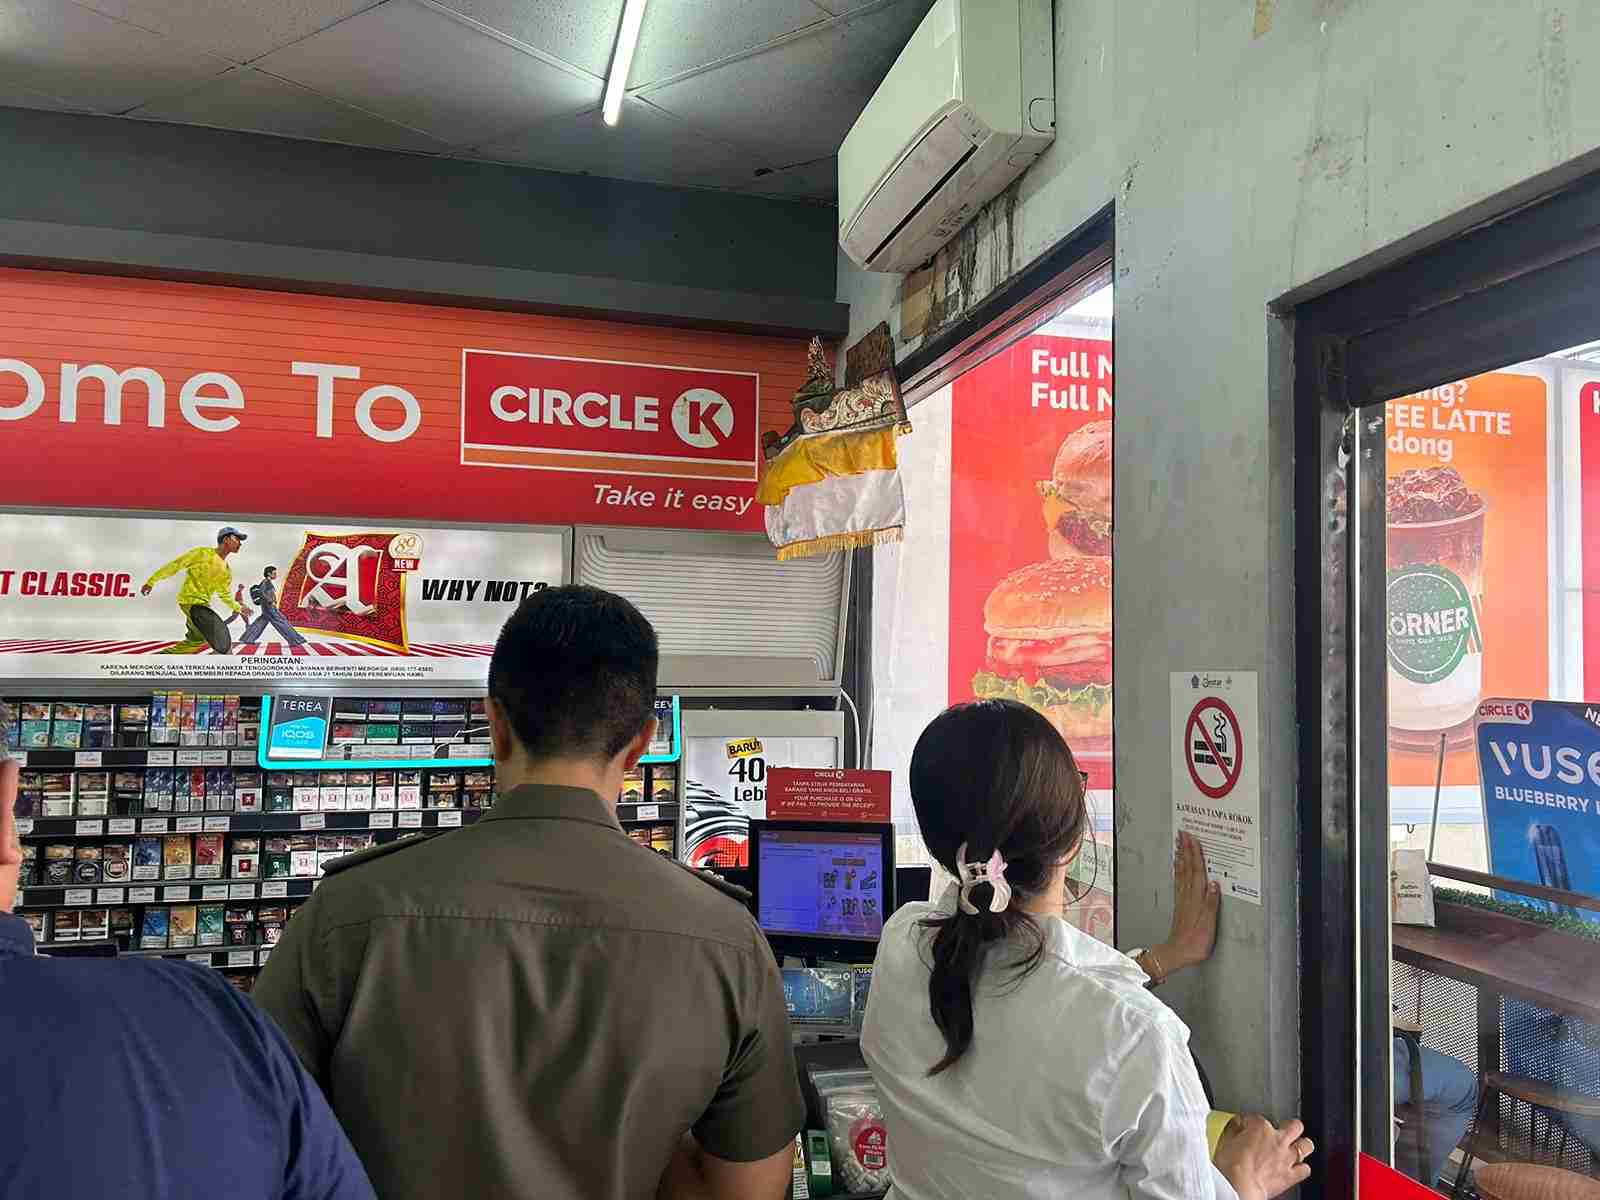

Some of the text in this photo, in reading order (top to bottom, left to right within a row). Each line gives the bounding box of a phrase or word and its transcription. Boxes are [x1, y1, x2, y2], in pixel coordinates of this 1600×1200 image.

[1031, 349, 1090, 379] Full
[291, 360, 423, 443] To
[489, 385, 660, 433] CIRCLE
[1031, 382, 1090, 412] Full
[1431, 403, 1512, 436] LATTE
[594, 484, 754, 516] Take it easy
[394, 558, 415, 570] NEW
[20, 571, 136, 598] CLASSIC.
[421, 578, 482, 602] WHY
[241, 656, 304, 665] PERINGATAN:
[281, 700, 322, 712] TEREA
[1479, 703, 1530, 720] CIRCLE K
[728, 740, 761, 755] BARU!
[1495, 785, 1589, 813] BLUEBERRY
